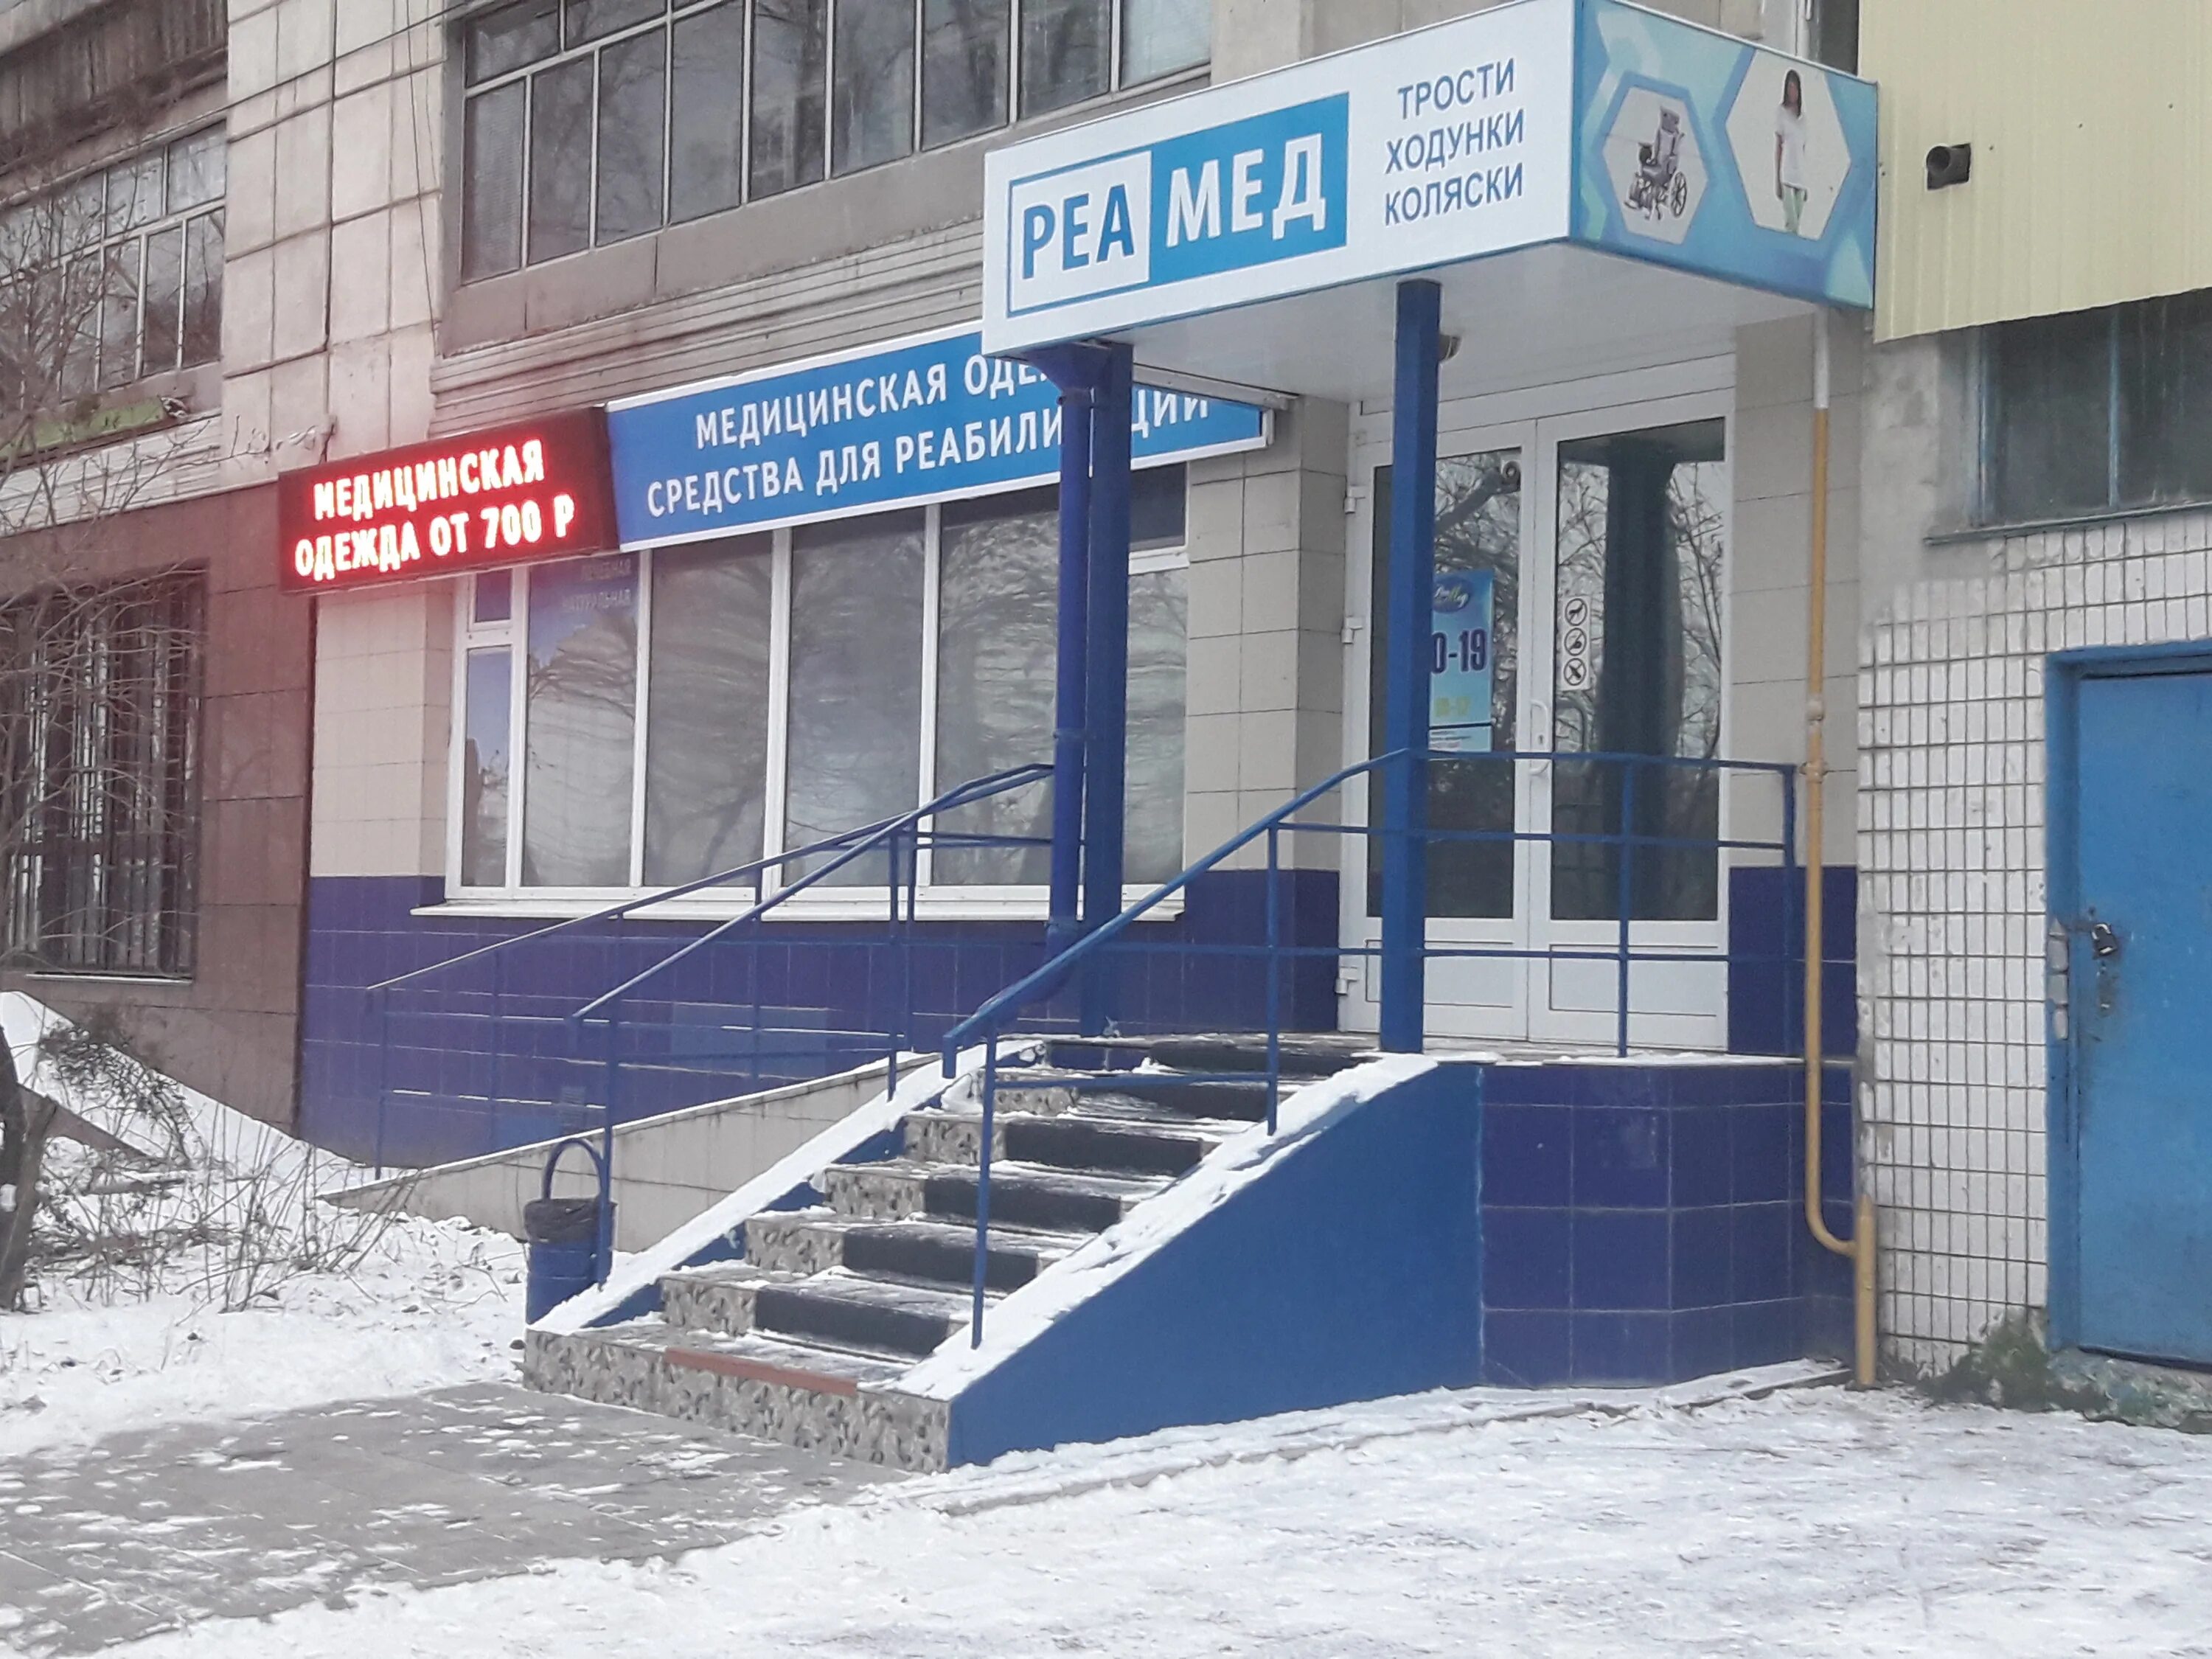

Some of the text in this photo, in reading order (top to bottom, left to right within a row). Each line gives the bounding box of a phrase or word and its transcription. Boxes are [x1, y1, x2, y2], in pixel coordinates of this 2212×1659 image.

[1398, 58, 1514, 119] ТРОСТИ
[1386, 108, 1525, 174] ХОДУНКИ
[1022, 133, 1326, 279] РЕА МЕД
[1384, 162, 1524, 226] КОЛЯСКИ
[695, 354, 1048, 449] МЕДИЦИНСКАЯ ОДЕ
[313, 439, 544, 521] МЕДИЦИНСКАЯ
[647, 389, 1209, 518] СРЕДСТВА ДЛЯ РЕАБИЛИЦИИ
[295, 493, 575, 581] ОДЕЖДА ОТ 700 Р
